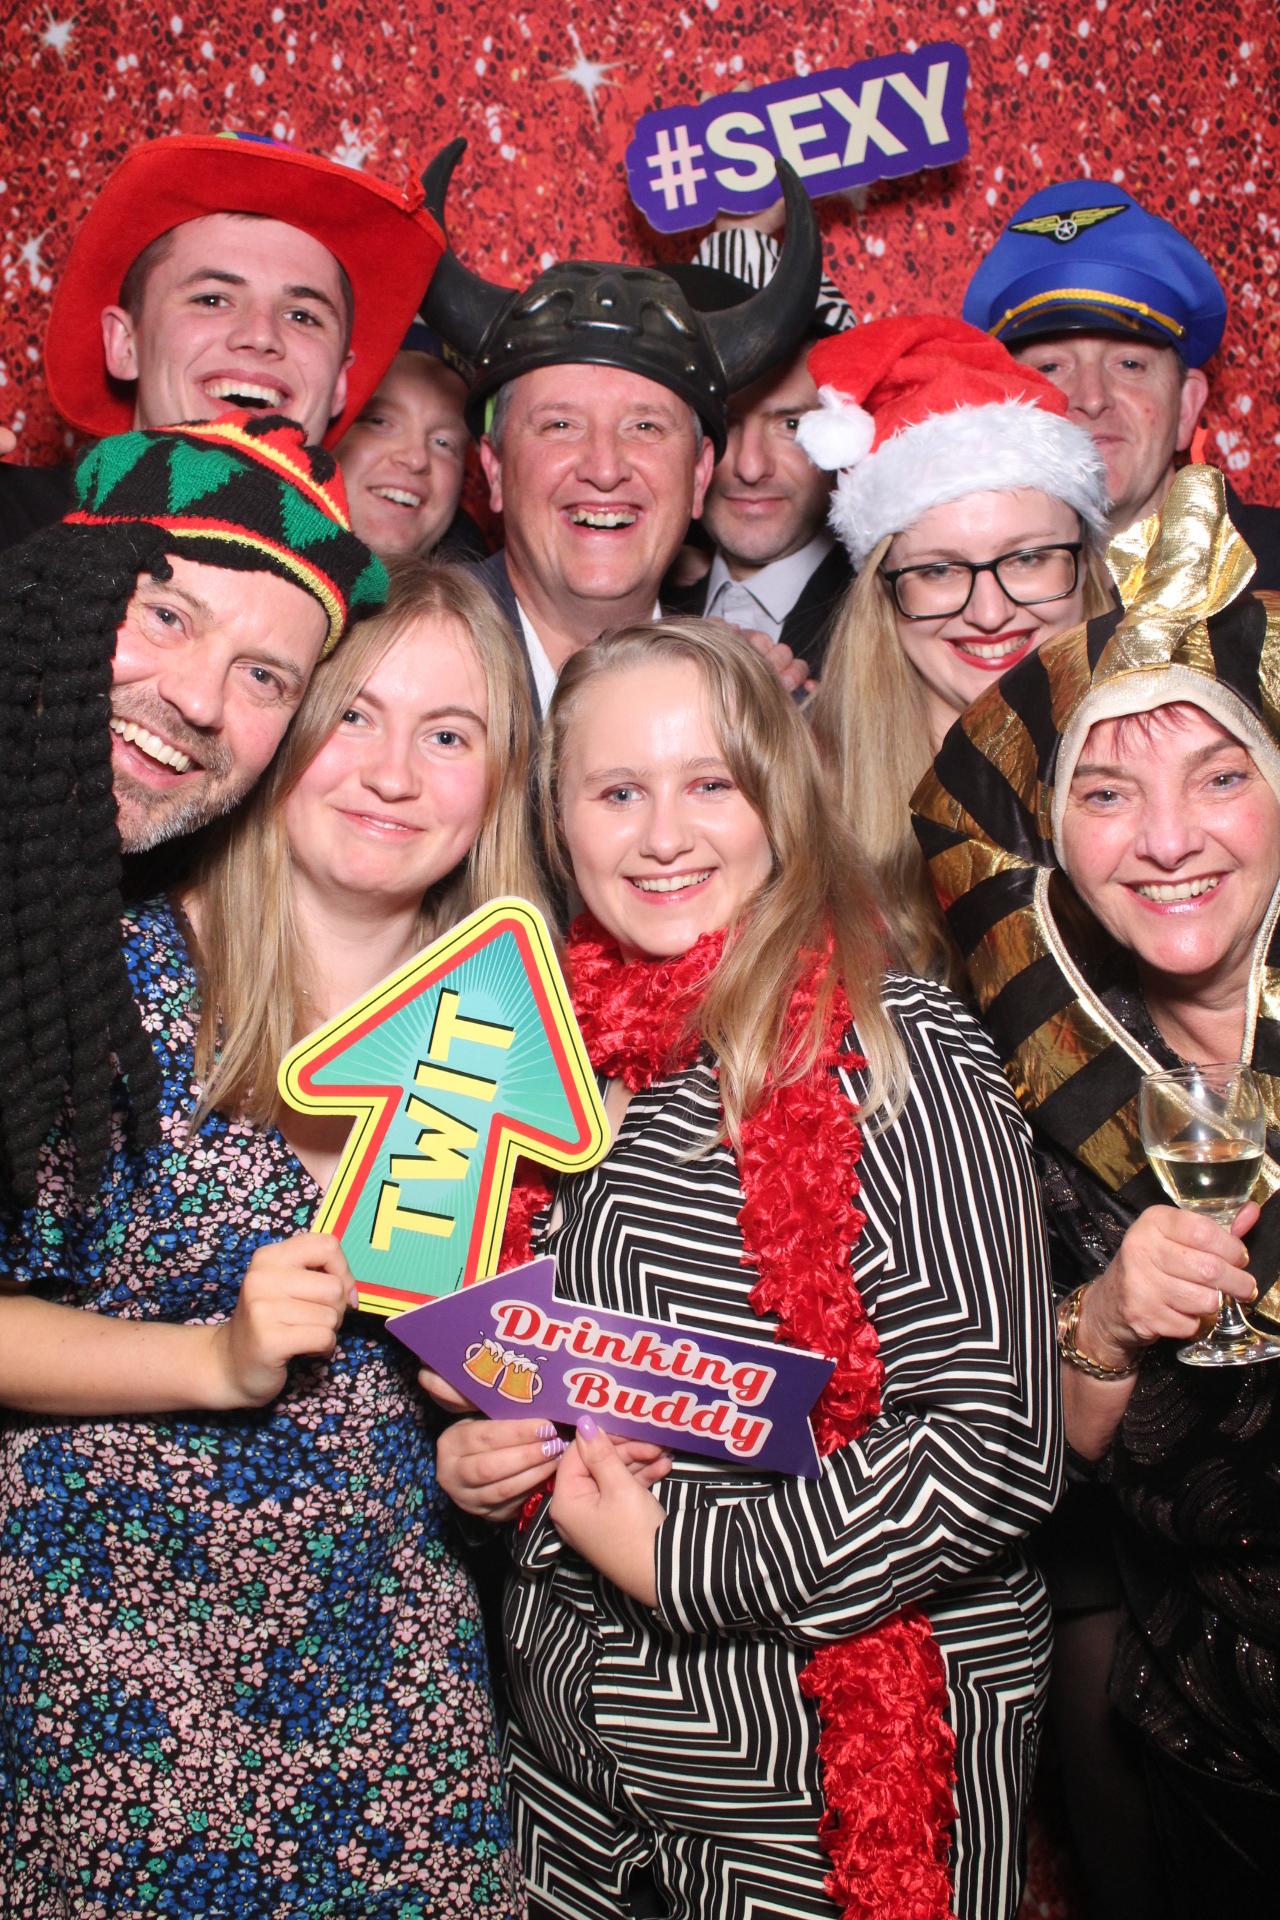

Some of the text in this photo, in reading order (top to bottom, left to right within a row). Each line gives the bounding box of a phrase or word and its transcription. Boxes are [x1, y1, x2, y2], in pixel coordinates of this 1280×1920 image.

[646, 61, 950, 211] #SEXY
[368, 986, 517, 1252] TWIT
[496, 1303, 771, 1399] Drinking
[569, 1371, 766, 1452] Buddy
